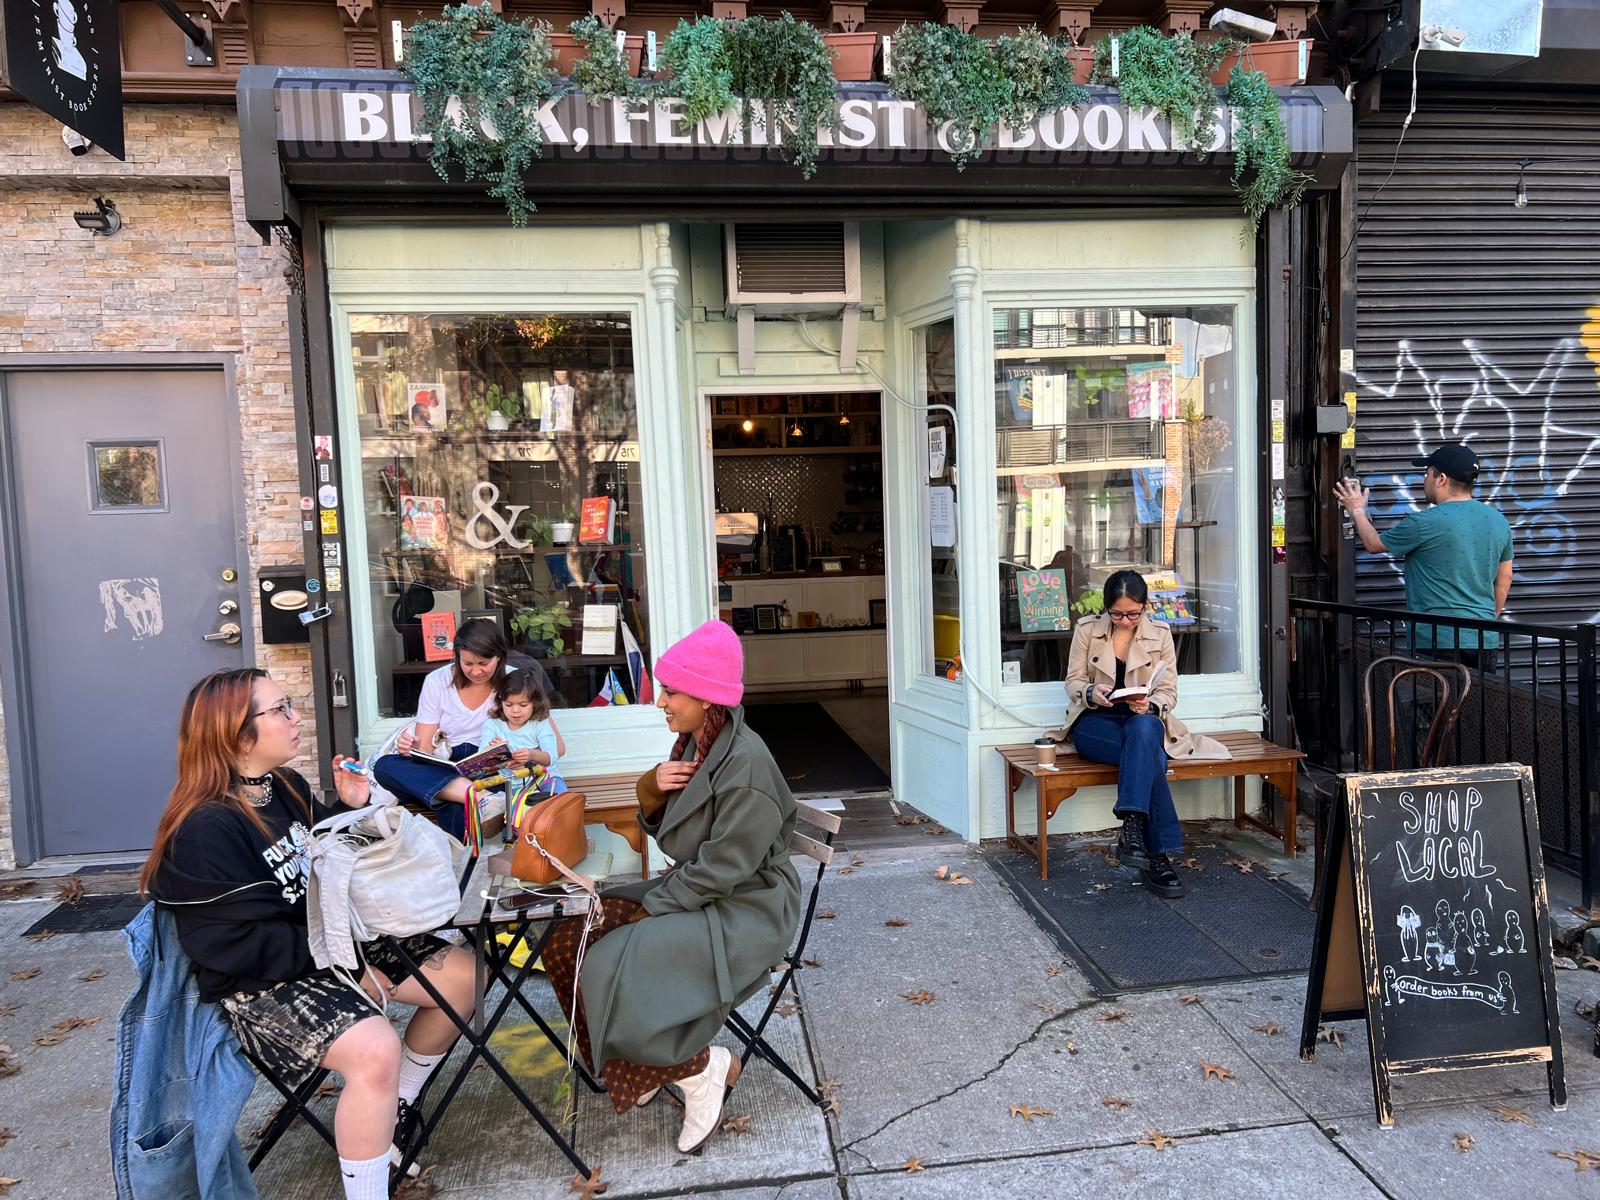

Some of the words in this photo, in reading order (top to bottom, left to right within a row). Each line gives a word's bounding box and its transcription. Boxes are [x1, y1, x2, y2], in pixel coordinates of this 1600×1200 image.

[612, 97, 916, 148] FEMINIST
[1013, 368, 1047, 377] DISSENT
[464, 481, 533, 550] &
[1021, 572, 1062, 593] Love
[1399, 787, 1483, 835] SHOP
[262, 835, 297, 868] FUCK
[1396, 830, 1497, 882] LOCAL
[1399, 980, 1428, 994] order
[1431, 986, 1458, 997] books
[1461, 985, 1484, 999] from
[1488, 994, 1498, 1002] us
